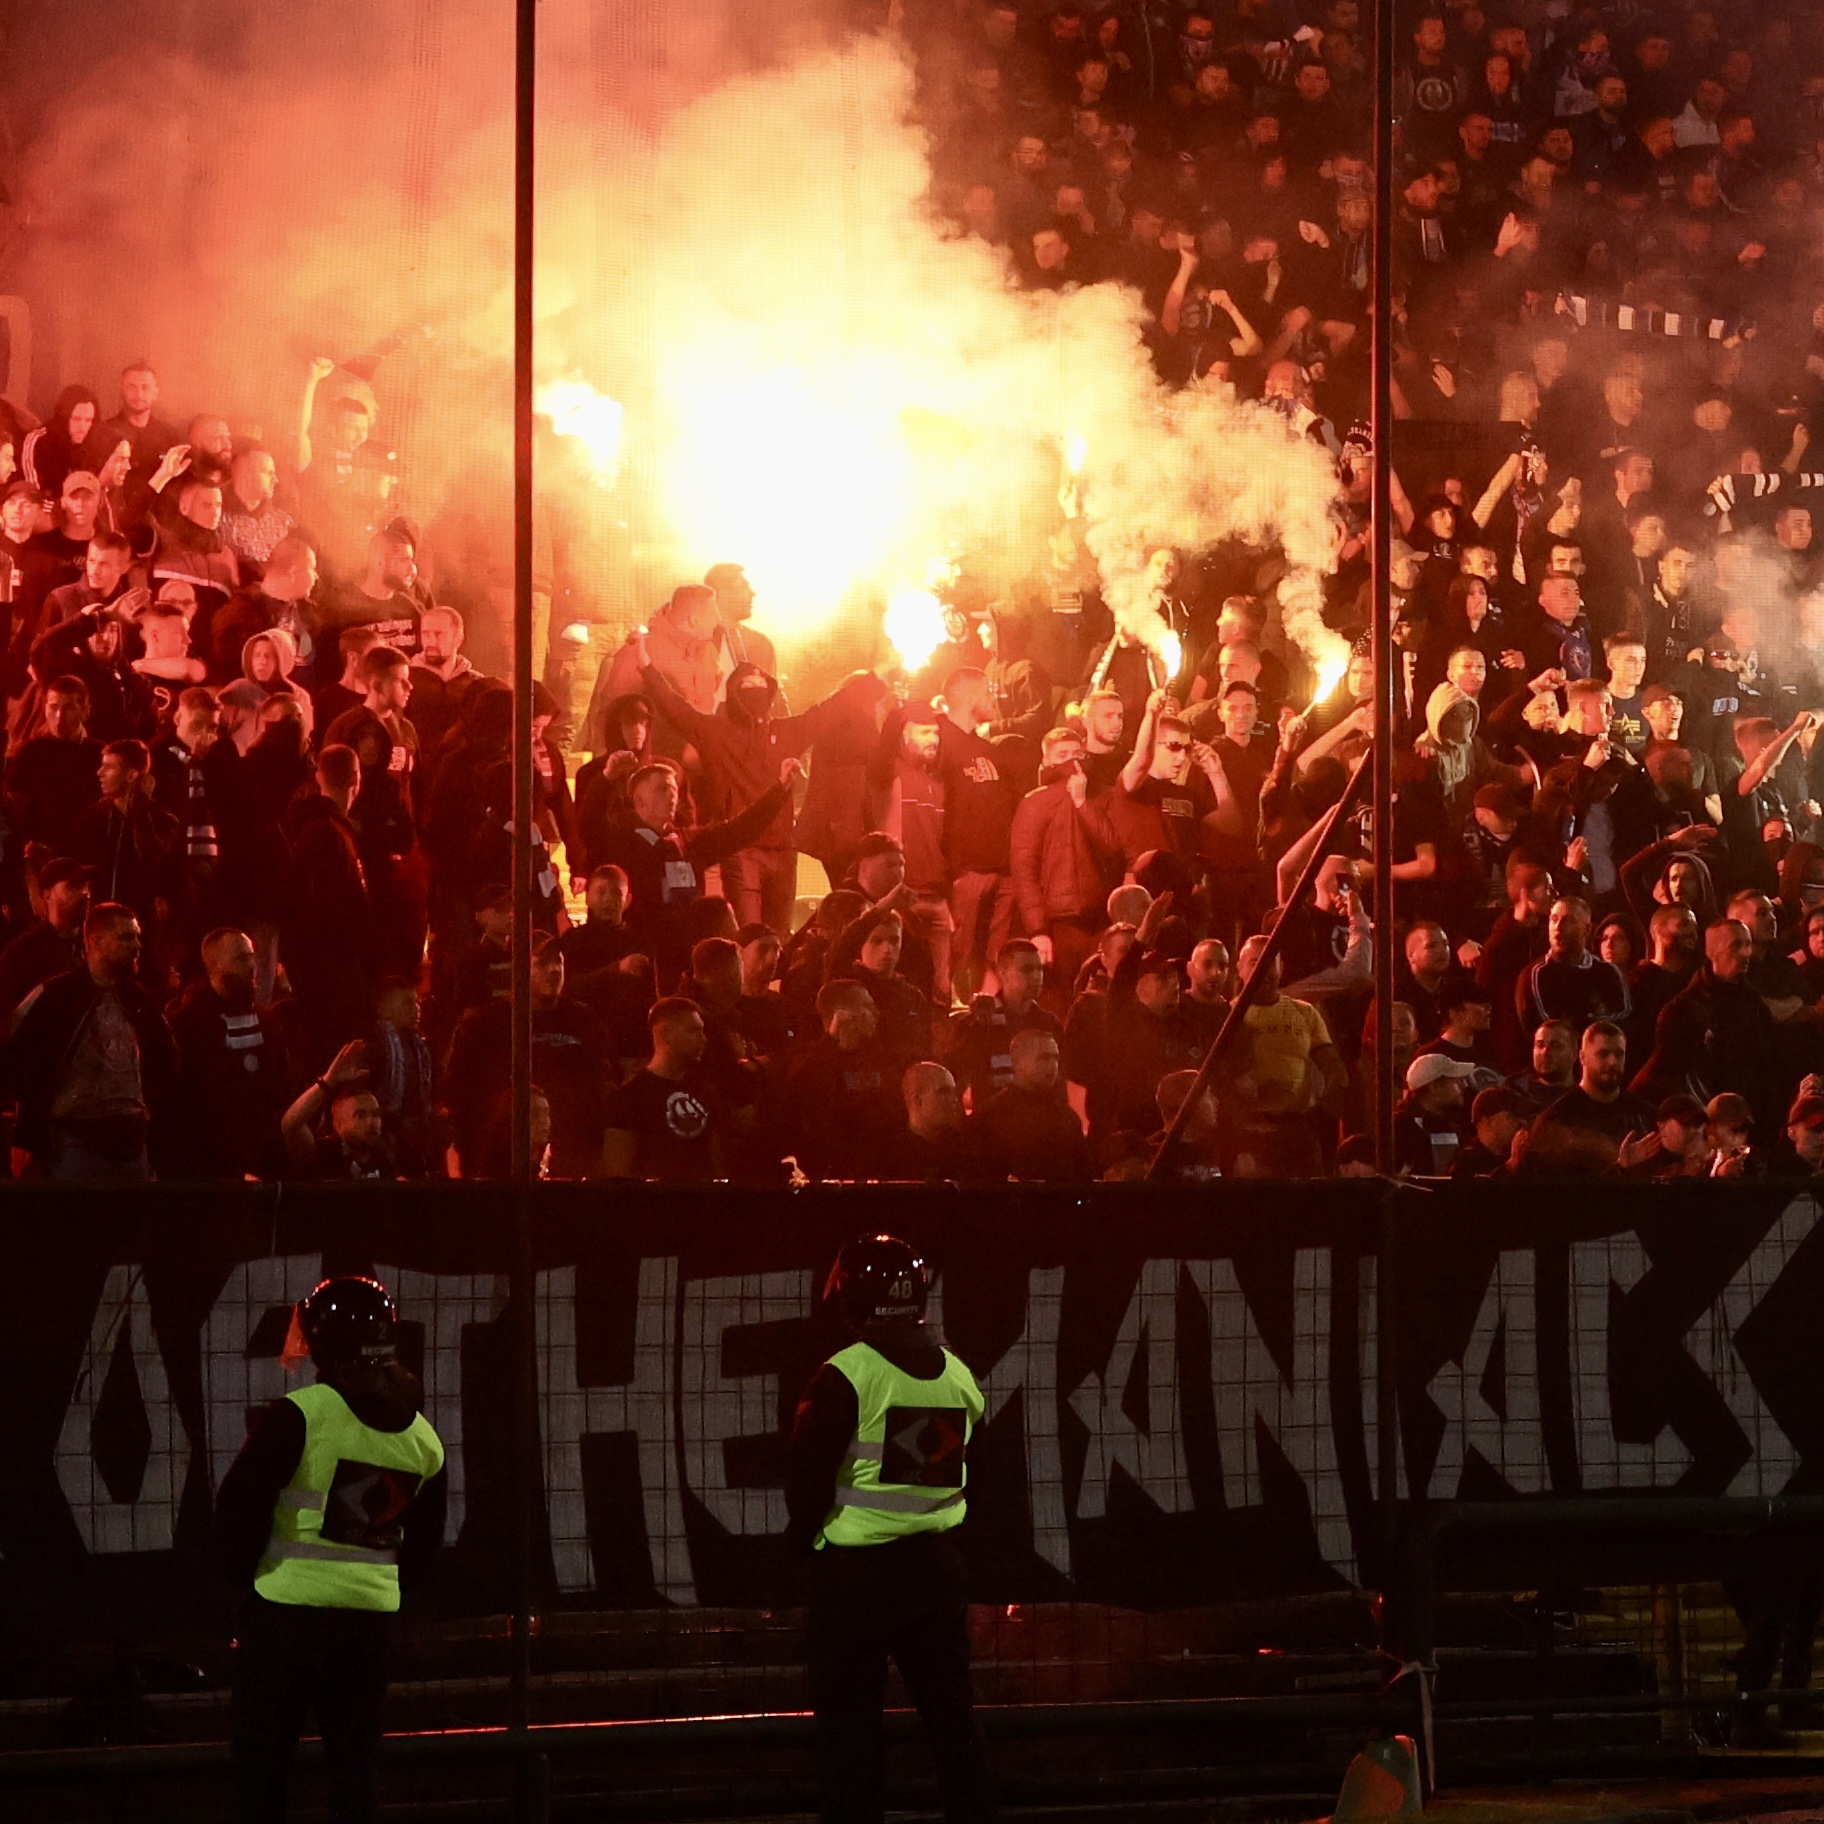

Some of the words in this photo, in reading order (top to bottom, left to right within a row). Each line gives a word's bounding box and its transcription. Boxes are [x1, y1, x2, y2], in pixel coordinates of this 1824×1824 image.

[888, 1280, 914, 1301] 48
[875, 1305, 920, 1317] SECURITY
[378, 1321, 387, 1340] 2
[372, 1256, 815, 1604] THE
